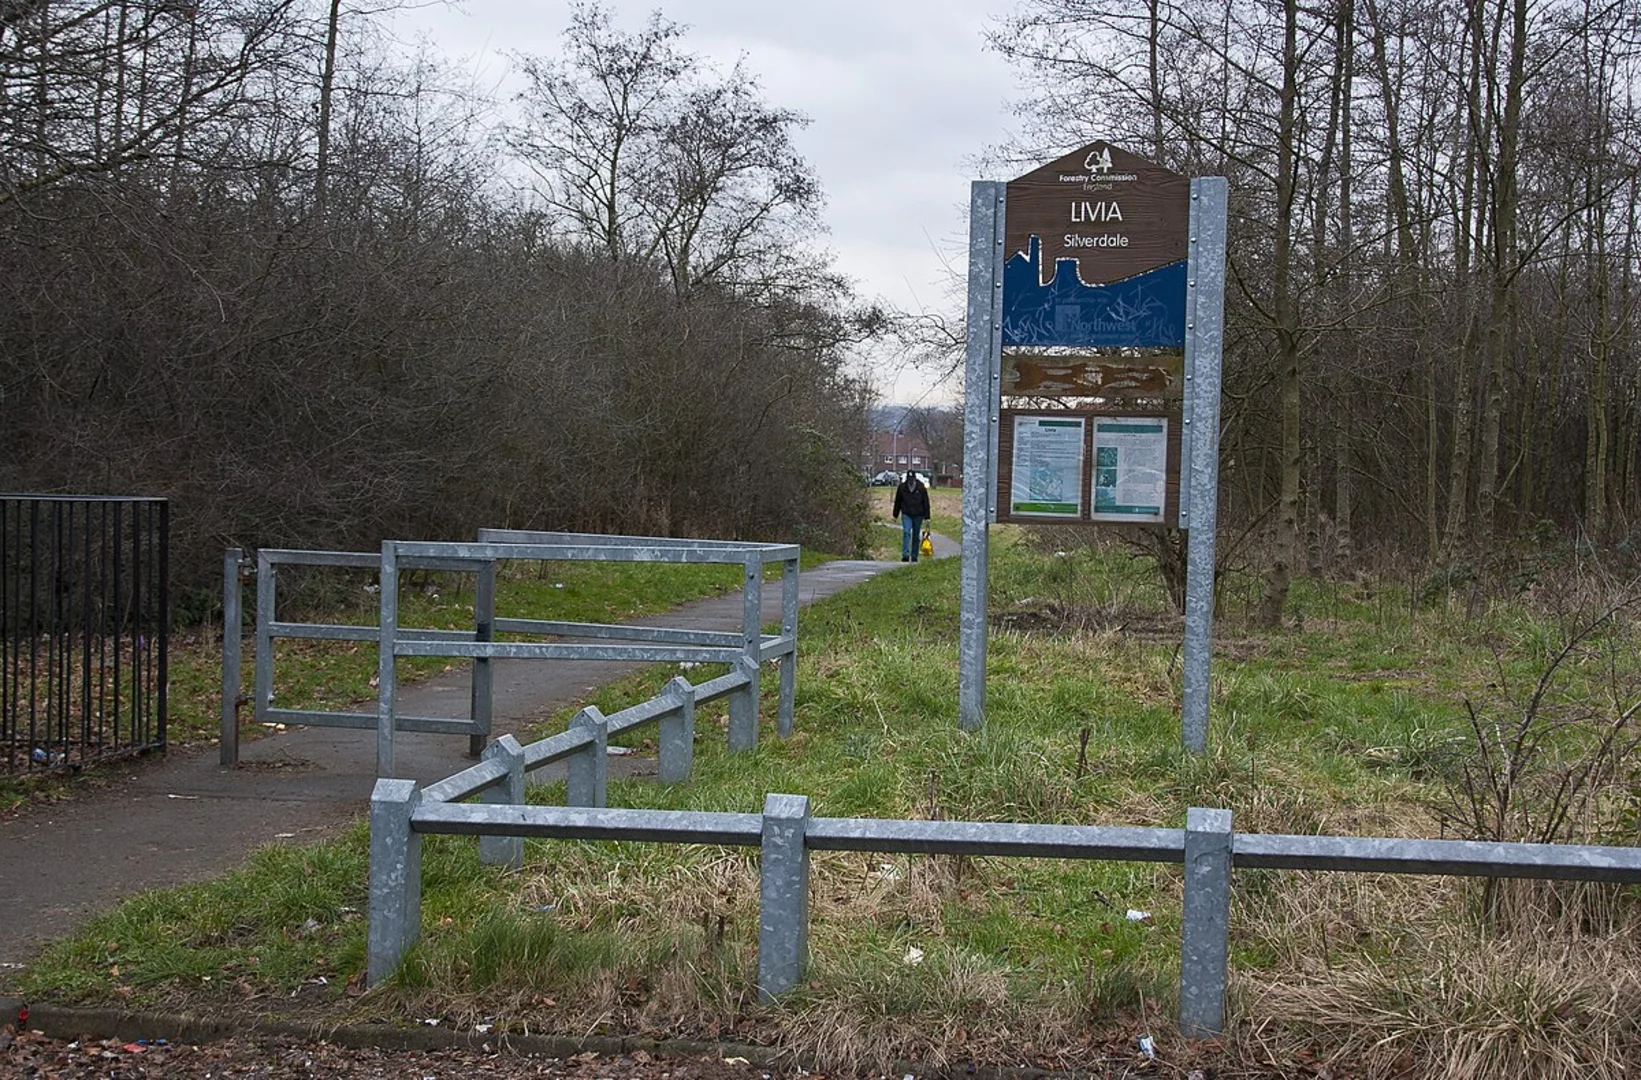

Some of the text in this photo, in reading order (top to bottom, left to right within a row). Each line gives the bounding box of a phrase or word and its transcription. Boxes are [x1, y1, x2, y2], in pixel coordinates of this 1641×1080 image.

[1059, 173, 1138, 182] Forestry Commission
[1083, 183, 1113, 192] England
[1071, 201, 1123, 222] LIVIA
[1063, 233, 1129, 247] Silverdale
[1070, 318, 1136, 332] Northwest
